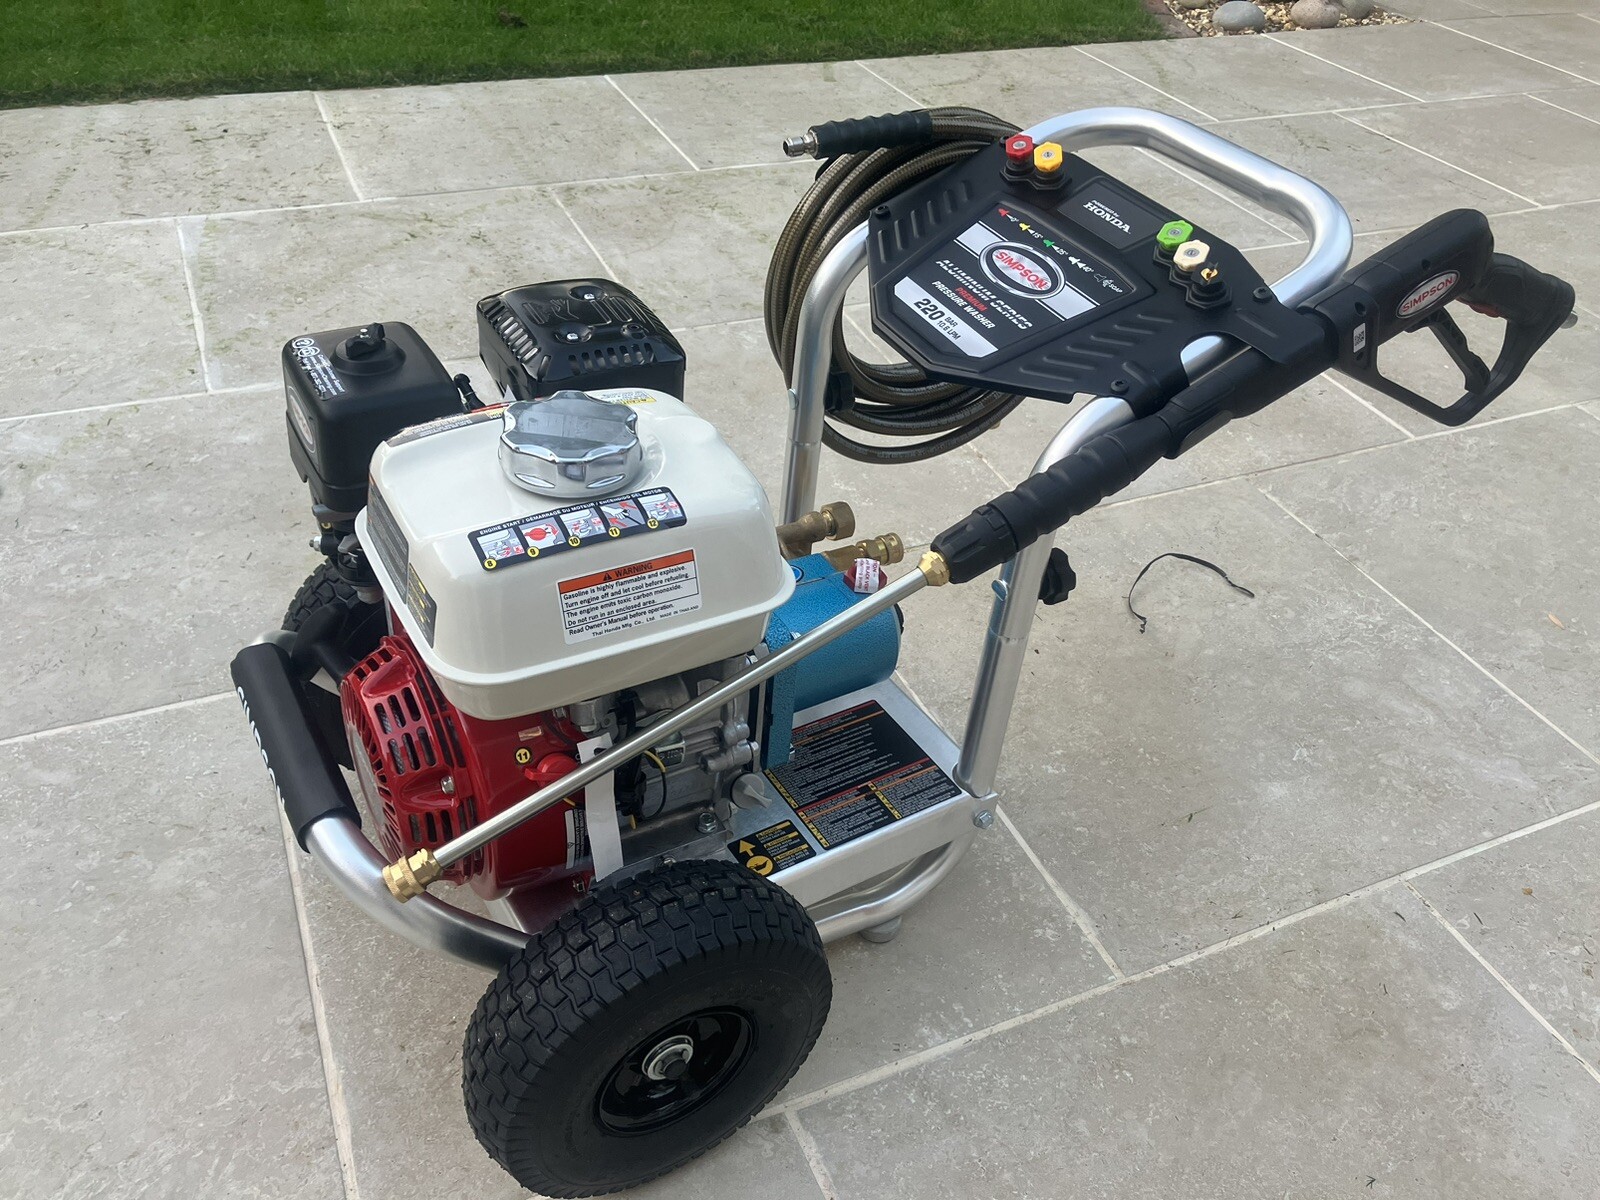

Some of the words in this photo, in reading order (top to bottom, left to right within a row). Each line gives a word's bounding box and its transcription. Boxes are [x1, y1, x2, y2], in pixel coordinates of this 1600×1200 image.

[1083, 202, 1130, 232] HONDA
[995, 251, 1051, 291] SIMPSON
[932, 280, 967, 307] PRESSURE
[963, 302, 996, 329] WASHER
[936, 259, 996, 301] ALUMINUM
[990, 300, 1033, 330] SERIES
[955, 287, 988, 312] PREMIUM
[1402, 275, 1454, 312] SIMPSON
[914, 298, 946, 320] 220
[944, 317, 958, 328] BAR
[947, 330, 961, 340] LPM
[480, 526, 502, 535] ENGINE
[572, 502, 595, 512] MOTEUR
[563, 590, 588, 600] Gasoline
[596, 583, 614, 592] highly
[615, 575, 646, 587] flammable
[660, 566, 686, 577] explosive.
[615, 562, 653, 577] WARNING
[579, 605, 599, 614] engine
[600, 601, 616, 609] emits
[633, 592, 654, 601] carbon
[654, 584, 683, 595] monoxide.
[580, 595, 600, 605] engine
[645, 580, 663, 588] before
[616, 602, 641, 613] enclosed
[569, 627, 584, 635] Read
[585, 621, 607, 631] Owner's
[608, 614, 628, 624] Manual
[629, 610, 647, 619] before
[648, 604, 674, 614] operation.
[518, 751, 529, 760] 11
